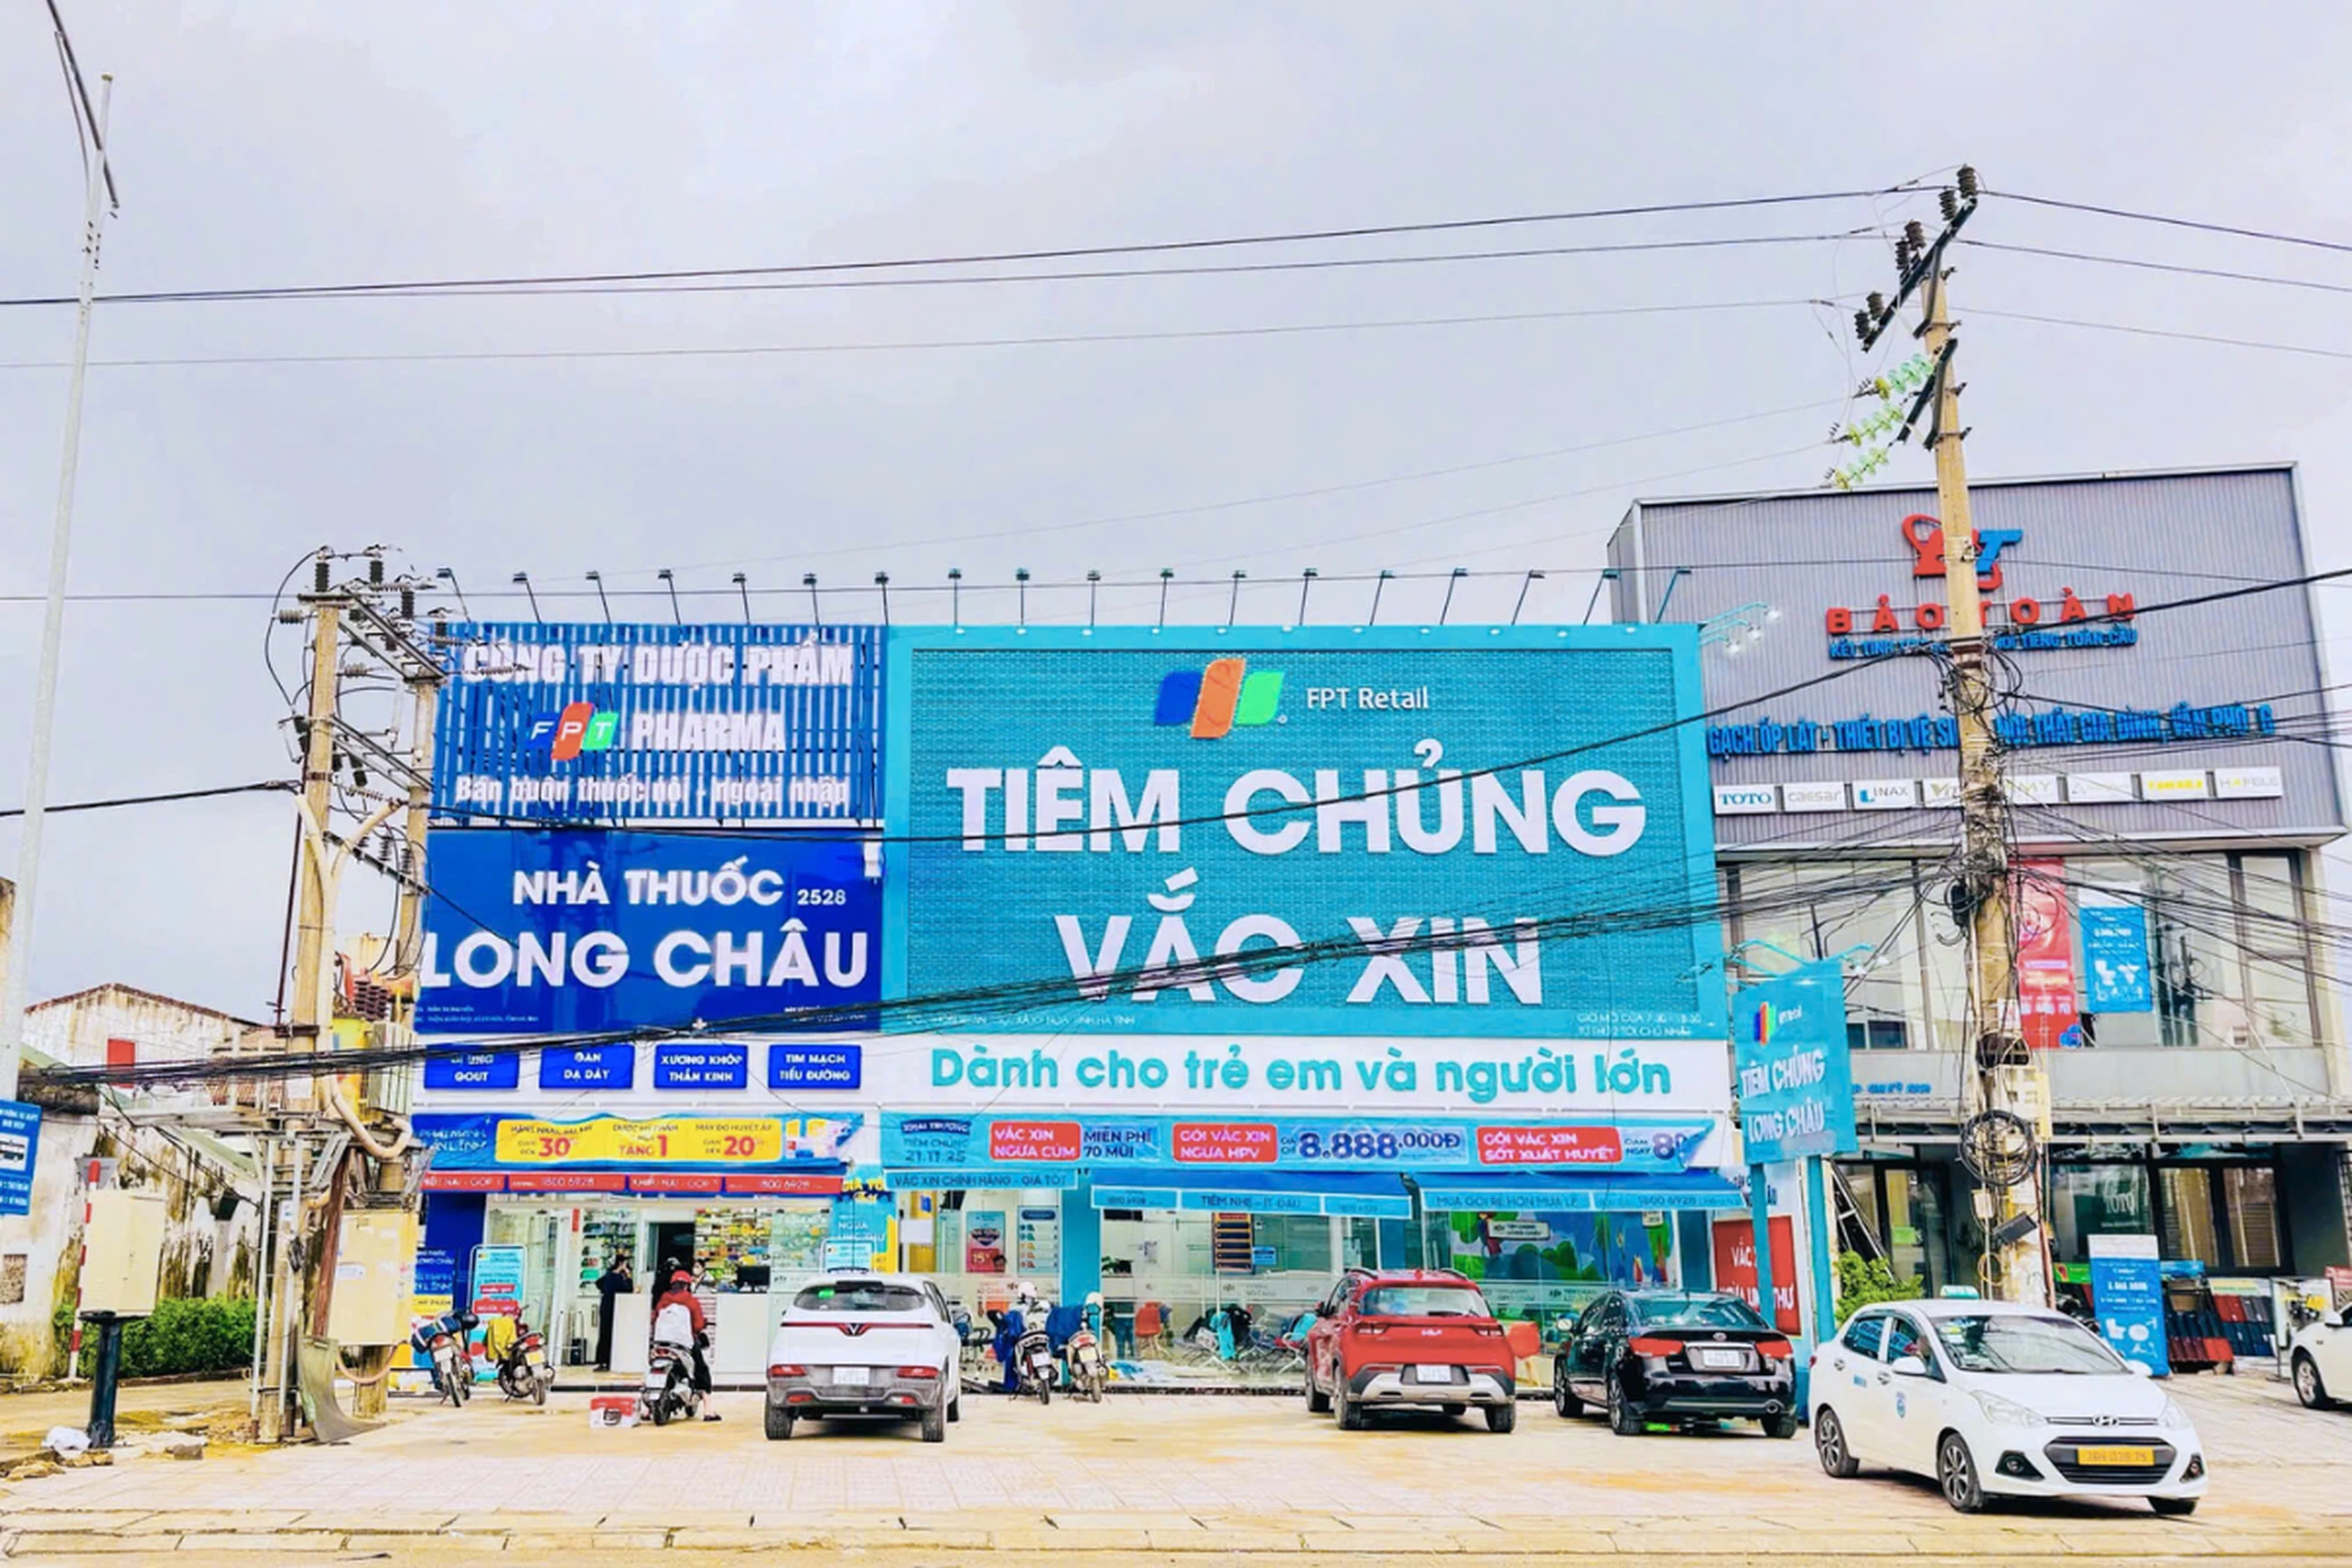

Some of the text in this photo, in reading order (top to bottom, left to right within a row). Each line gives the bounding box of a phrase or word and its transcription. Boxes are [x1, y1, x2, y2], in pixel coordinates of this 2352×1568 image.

[1826, 593, 1945, 634] BẢO
[578, 645, 623, 682] TY
[634, 641, 734, 691] DƯỢC
[743, 632, 854, 685] PHẨM
[1306, 686, 1429, 709] FPT Retail
[530, 721, 613, 741] FPT
[632, 713, 786, 750] PHARMA
[2031, 705, 2075, 744] THẤT
[2078, 712, 2110, 742] GIA
[1709, 724, 1754, 761] GẠCH
[1759, 715, 1782, 753] ỐP
[1833, 713, 1882, 750] THIẾT
[946, 738, 1647, 856] TIÊM CHỦNG
[1720, 793, 1772, 806] TOTO
[513, 855, 845, 906] NHÀ THUỐC 2528
[1054, 867, 1544, 1006] VẮC XIN
[420, 918, 868, 989] LONG CHÂU
[574, 1053, 601, 1063] GAN
[786, 1054, 845, 1067] TIM MẠCH
[454, 1071, 489, 1081] GOUT
[704, 1071, 733, 1082] KINH
[932, 1044, 1672, 1103] Dành cho trẻ em và người lớn
[1741, 1043, 1826, 1099] TIÊM CHỦNG
[1747, 1097, 1825, 1143] LONG CHÂU
[994, 1125, 1055, 1142] VẮC XIN
[1083, 1126, 1122, 1143] MIỄN
[1179, 1127, 1207, 1142] GÓI
[1245, 1130, 1272, 1143] XIN
[1483, 1132, 1511, 1145] GÓI
[1551, 1133, 1577, 1145] XIN
[994, 1145, 1076, 1158] NGỪA CÚM
[1083, 1145, 1135, 1158] 70 MŨI
[1180, 1145, 1260, 1159] NGỪA HPV
[1485, 1145, 1616, 1161] SỐT XUẤT HUYẾT
[922, 1175, 940, 1187] XIN
[942, 1173, 977, 1187] CHÍNH
[1201, 1193, 1227, 1206] TIÊM
